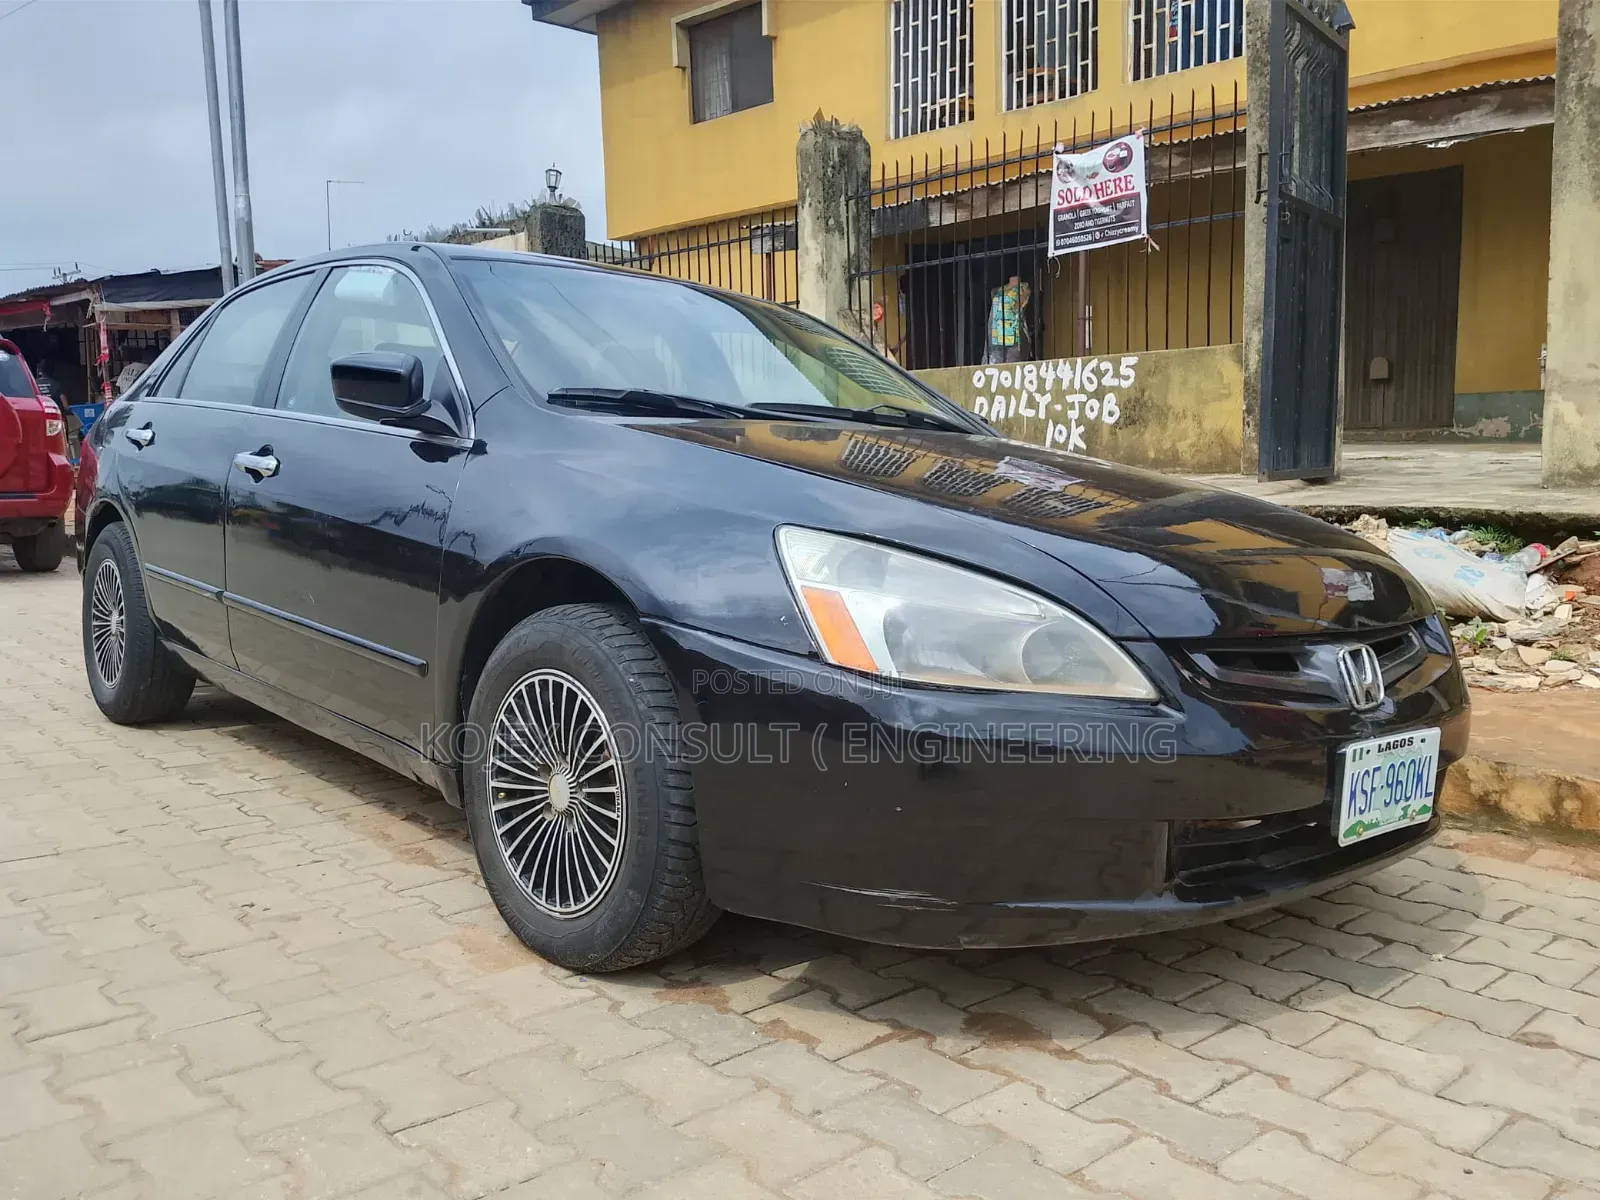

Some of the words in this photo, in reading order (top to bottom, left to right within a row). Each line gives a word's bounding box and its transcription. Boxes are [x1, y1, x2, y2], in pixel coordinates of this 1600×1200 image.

[1057, 186, 1092, 206] SOLD
[1094, 175, 1135, 199] HERE
[972, 356, 1138, 393] 07018441625
[1045, 418, 1087, 452] 10K
[1377, 736, 1414, 753] LAGOS
